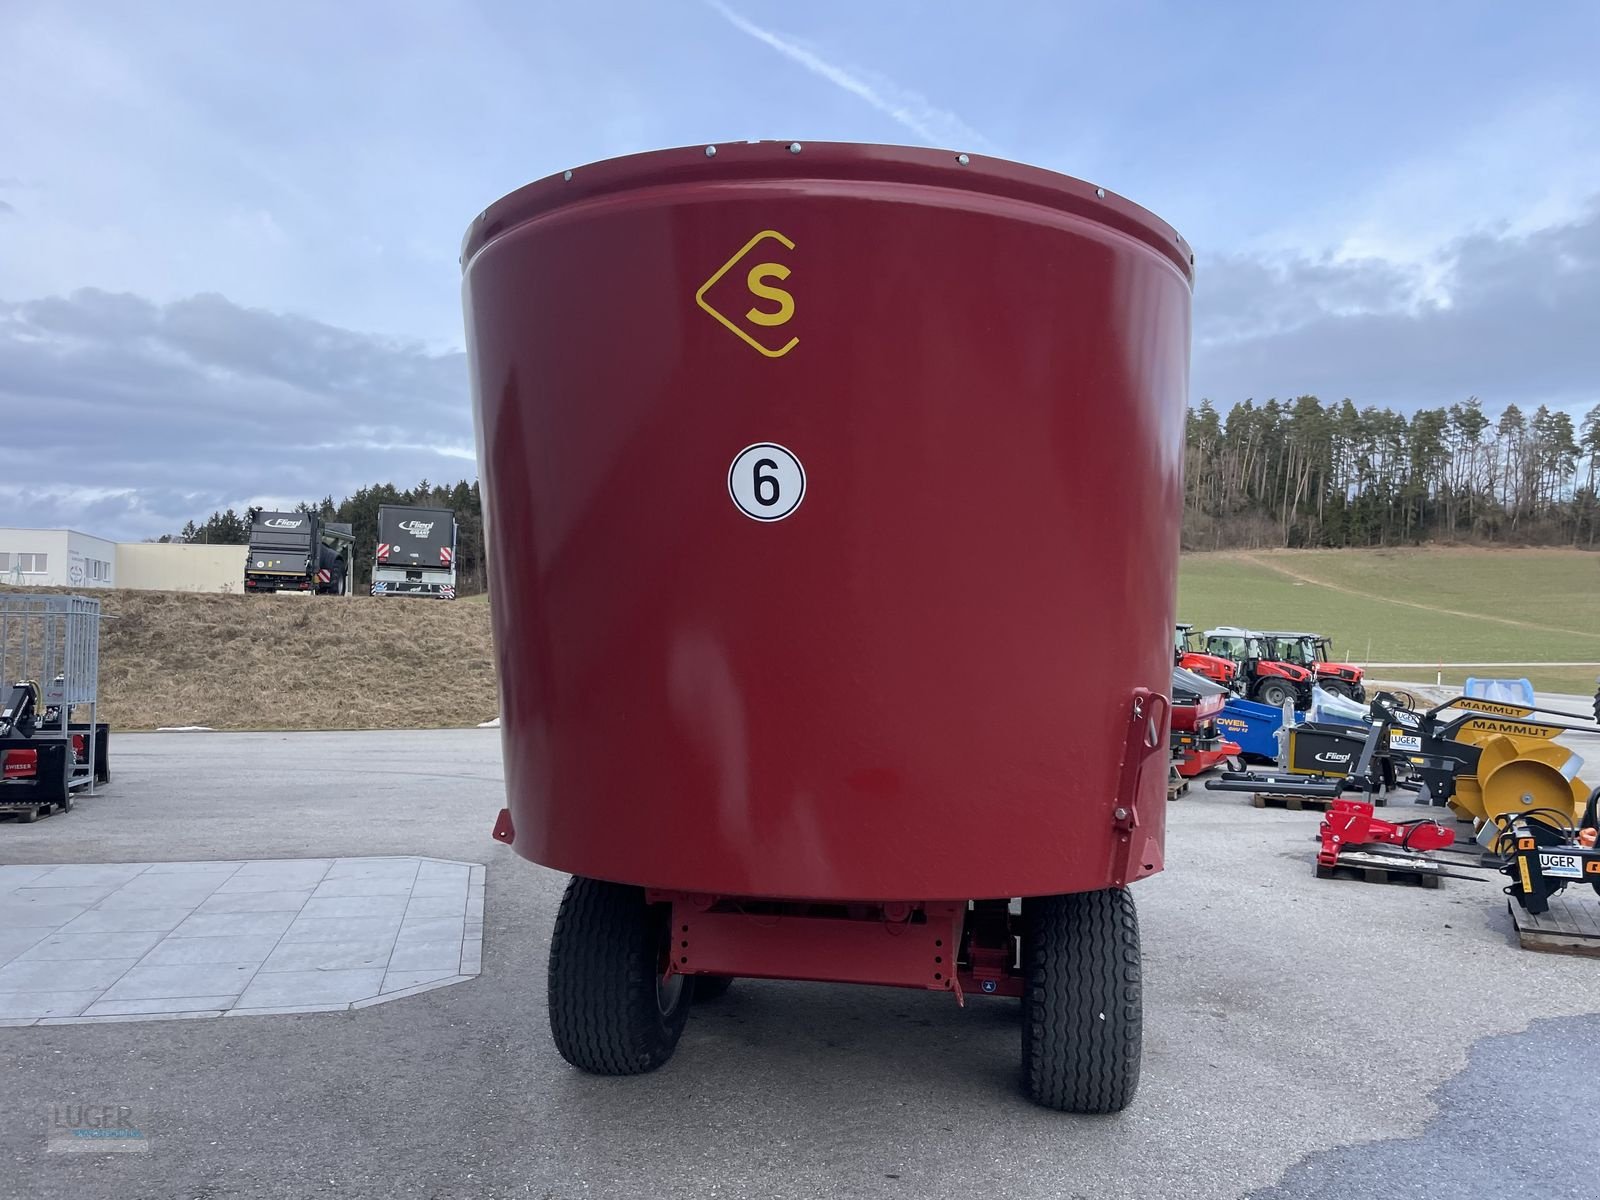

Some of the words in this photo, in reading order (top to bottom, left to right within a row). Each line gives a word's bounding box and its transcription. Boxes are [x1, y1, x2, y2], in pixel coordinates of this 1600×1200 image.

[745, 263, 795, 326] S
[753, 458, 780, 506] 6
[274, 518, 303, 528] Fliegl
[407, 519, 434, 529] Fliegl
[1460, 701, 1522, 716] MAMMUT
[1472, 721, 1548, 737] MAMMUT
[1391, 736, 1416, 745] LUGER
[1325, 752, 1351, 763] Fliegl
[1541, 855, 1575, 867] UGER
